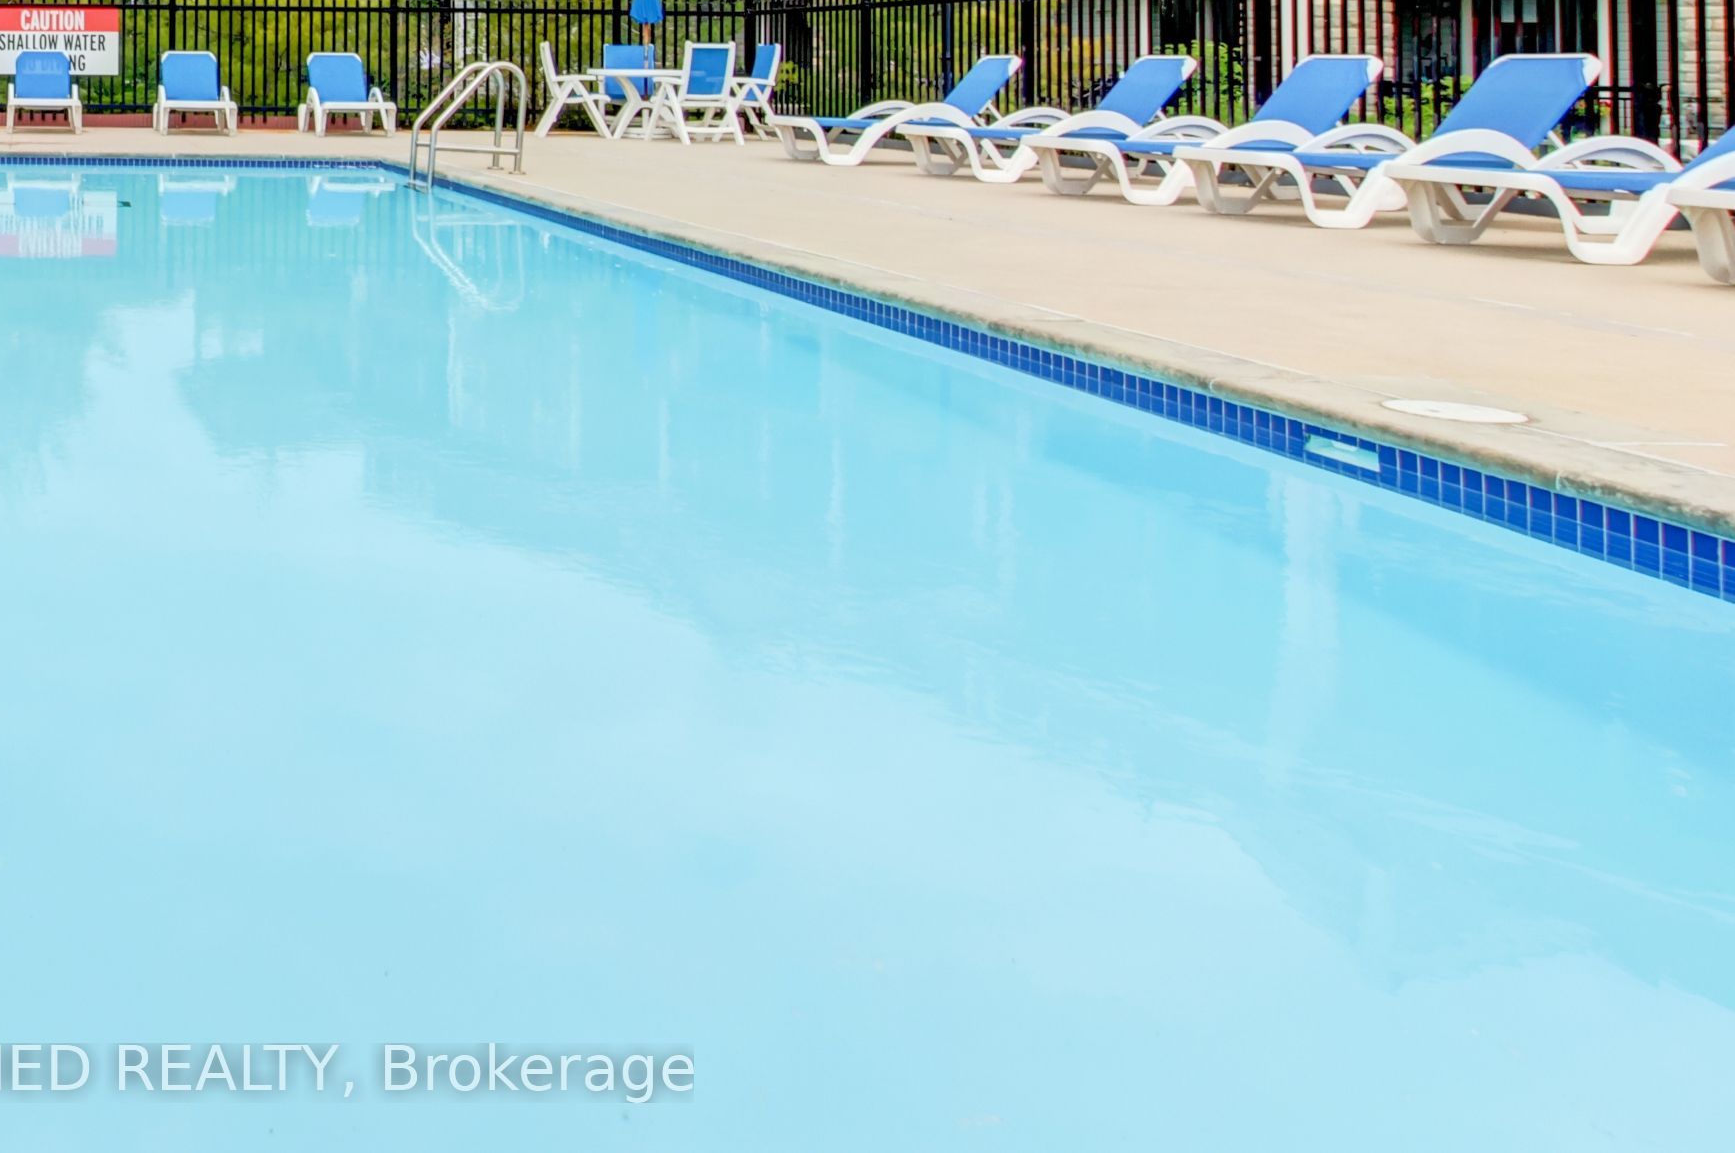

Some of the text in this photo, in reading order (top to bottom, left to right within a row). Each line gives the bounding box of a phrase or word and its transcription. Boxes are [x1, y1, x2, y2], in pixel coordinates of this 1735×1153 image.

[20, 10, 85, 31] CAUTION
[0, 33, 106, 51] SHALLOW WATER
